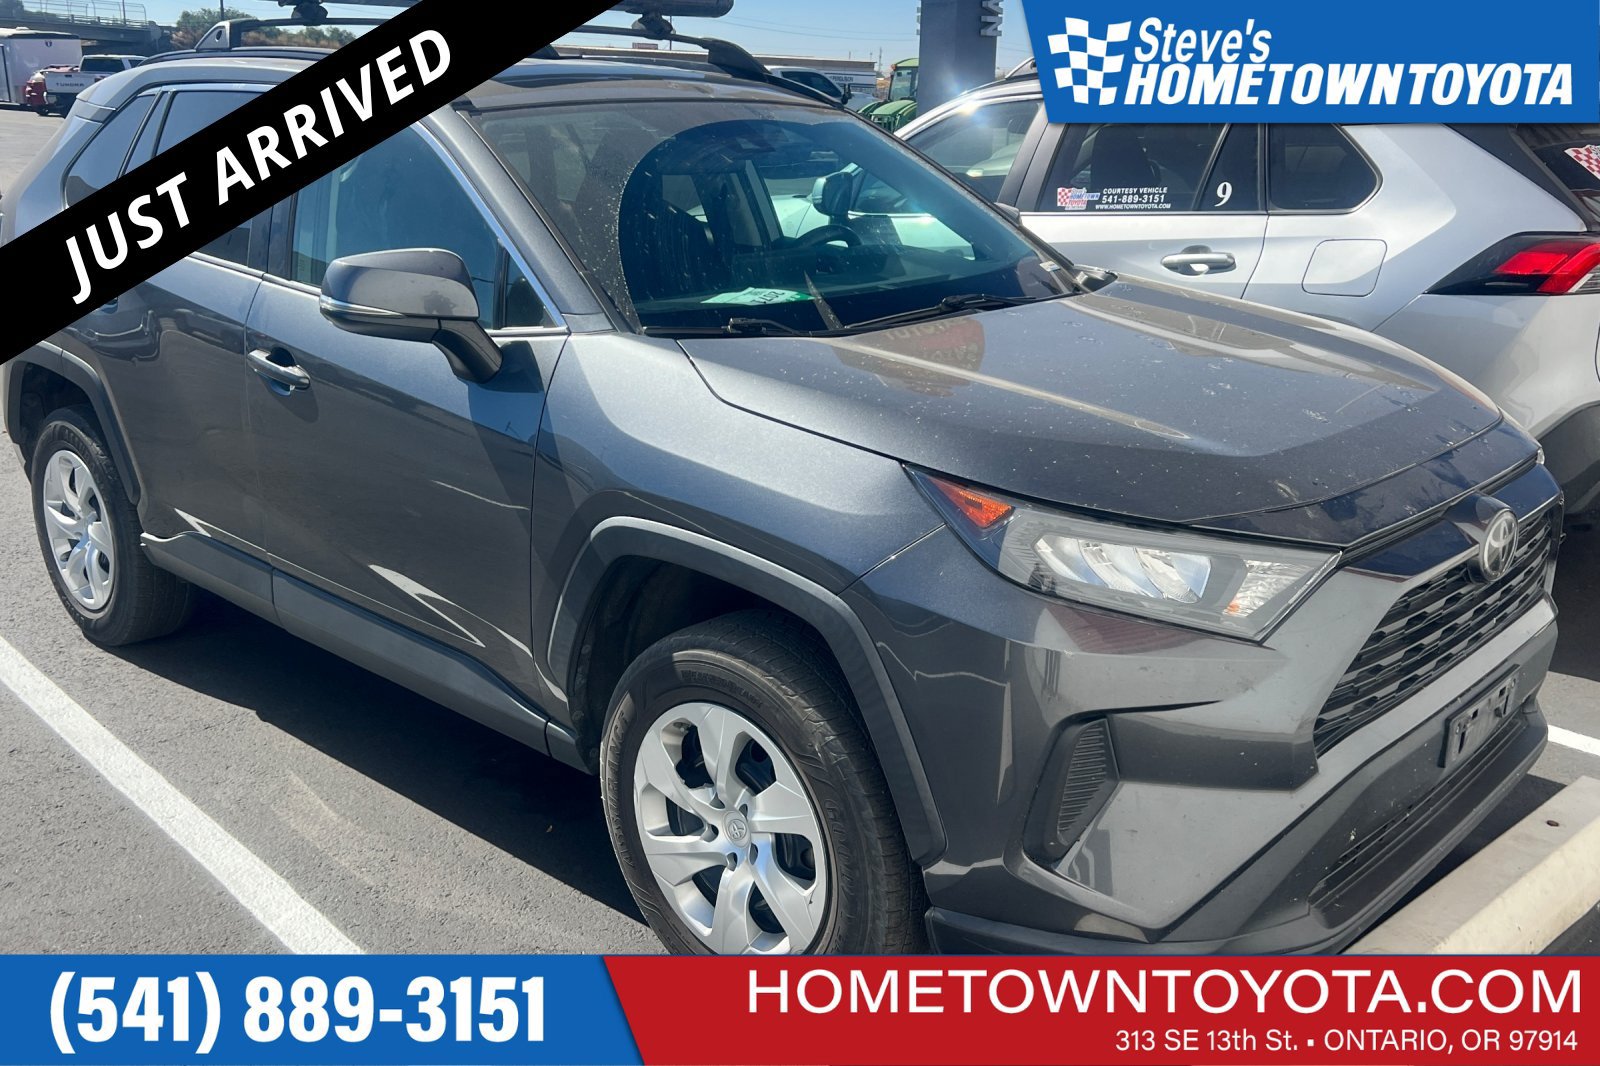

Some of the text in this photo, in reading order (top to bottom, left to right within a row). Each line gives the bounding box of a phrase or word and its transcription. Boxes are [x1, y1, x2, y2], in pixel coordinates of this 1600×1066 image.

[1103, 187, 1138, 195] COURTESY
[1214, 181, 1233, 207] 9
[1102, 194, 1165, 204] 541-889-3151
